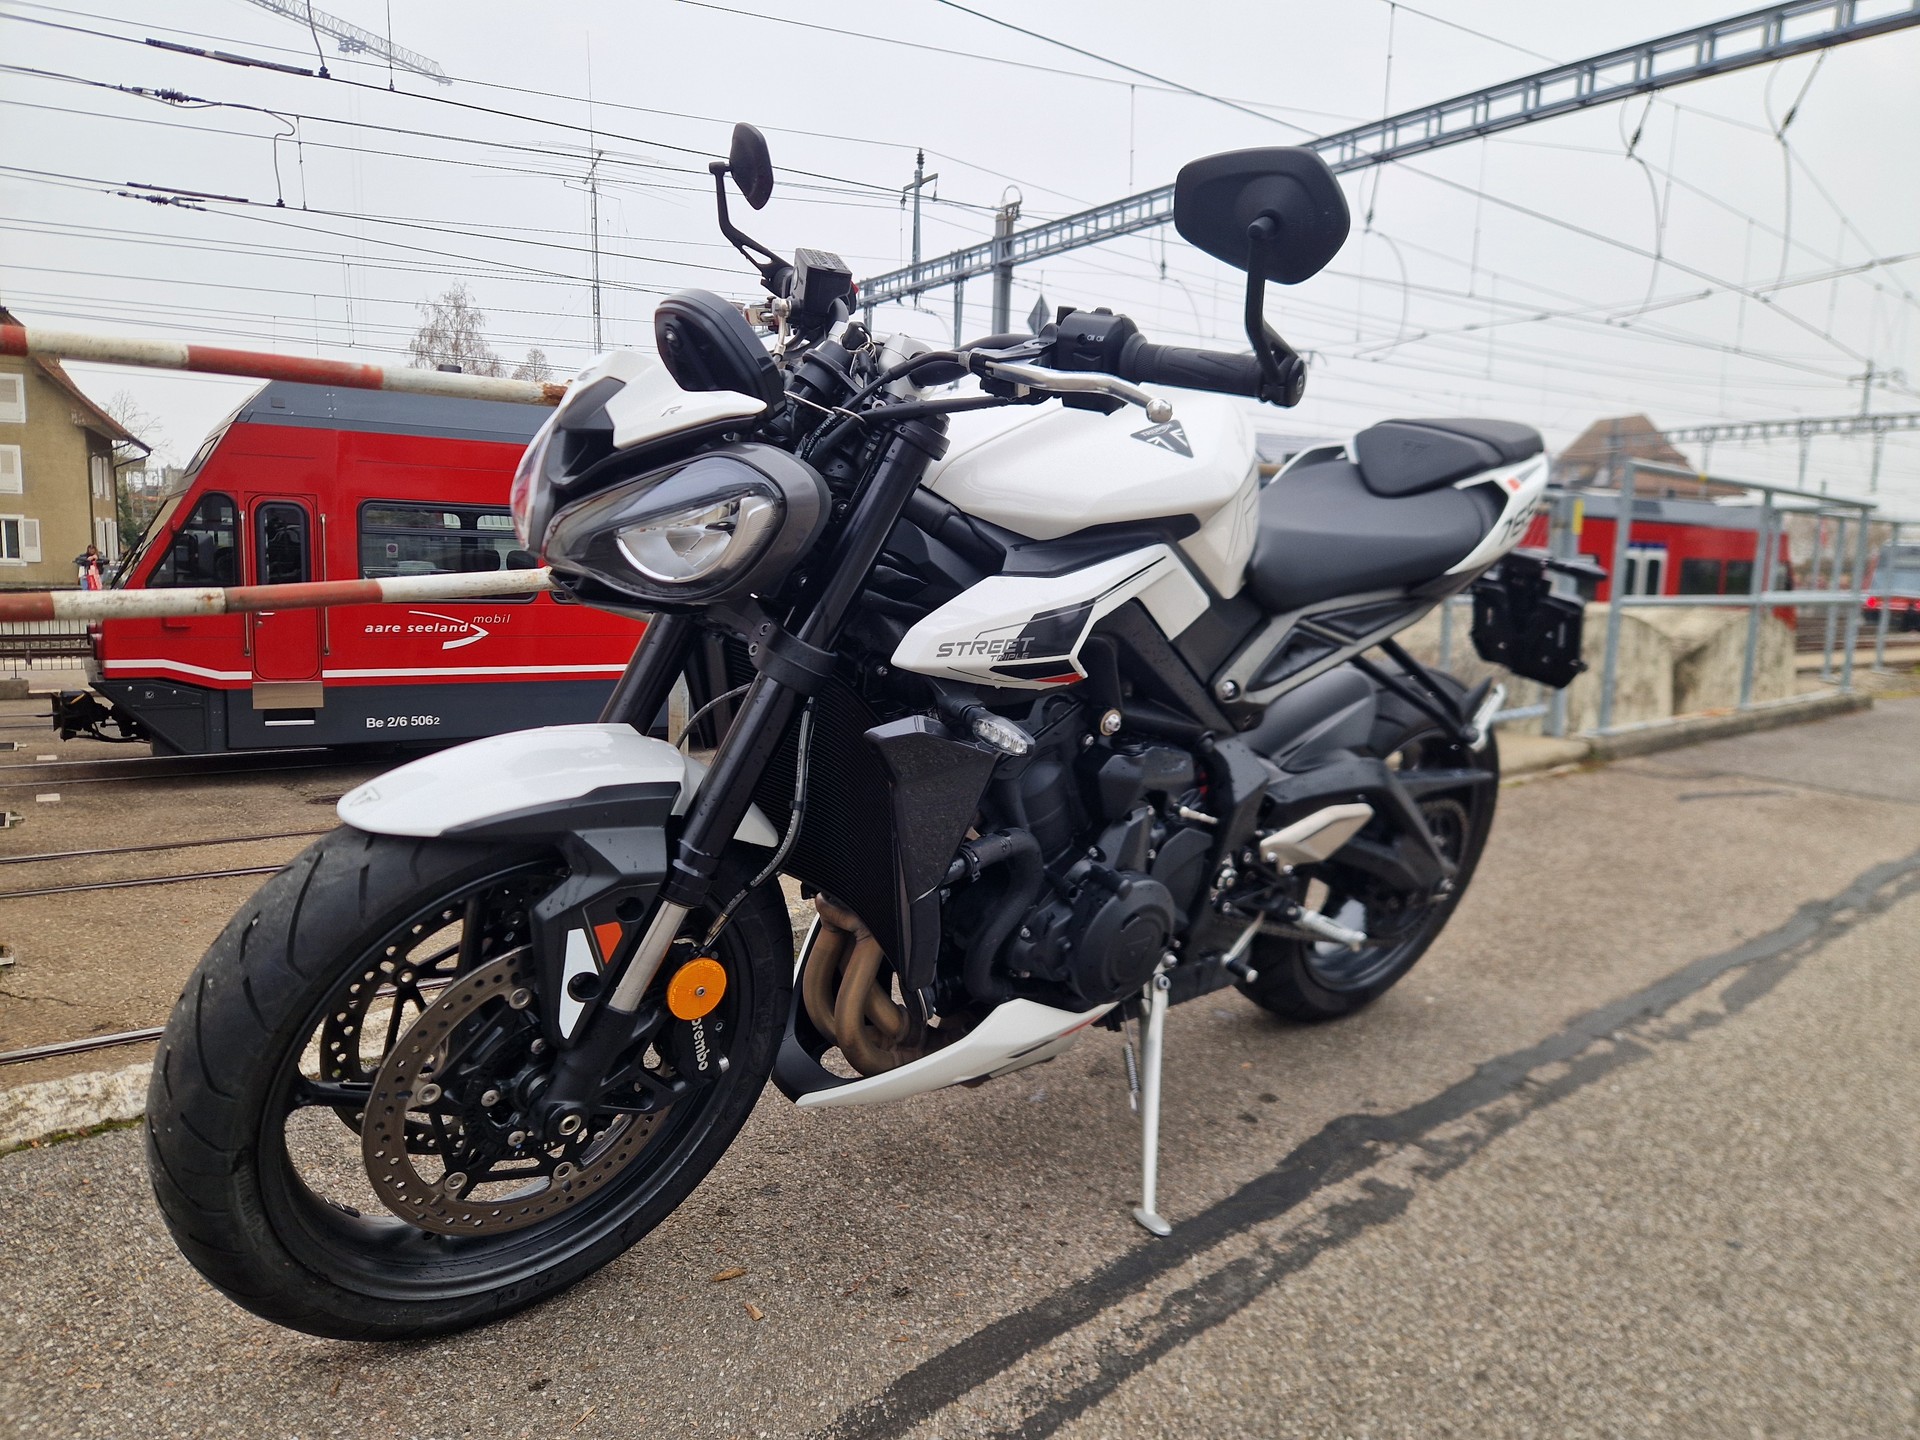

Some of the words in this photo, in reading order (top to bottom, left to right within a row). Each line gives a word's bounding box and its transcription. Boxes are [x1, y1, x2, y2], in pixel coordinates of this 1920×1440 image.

[365, 624, 401, 633] aare
[407, 622, 469, 633] seeland
[473, 614, 511, 624] mobil
[936, 637, 1035, 658] STREET
[990, 652, 1030, 662] TRIPLE
[366, 717, 384, 729] Be
[387, 716, 408, 727] 2/6
[410, 715, 441, 726] 5062
